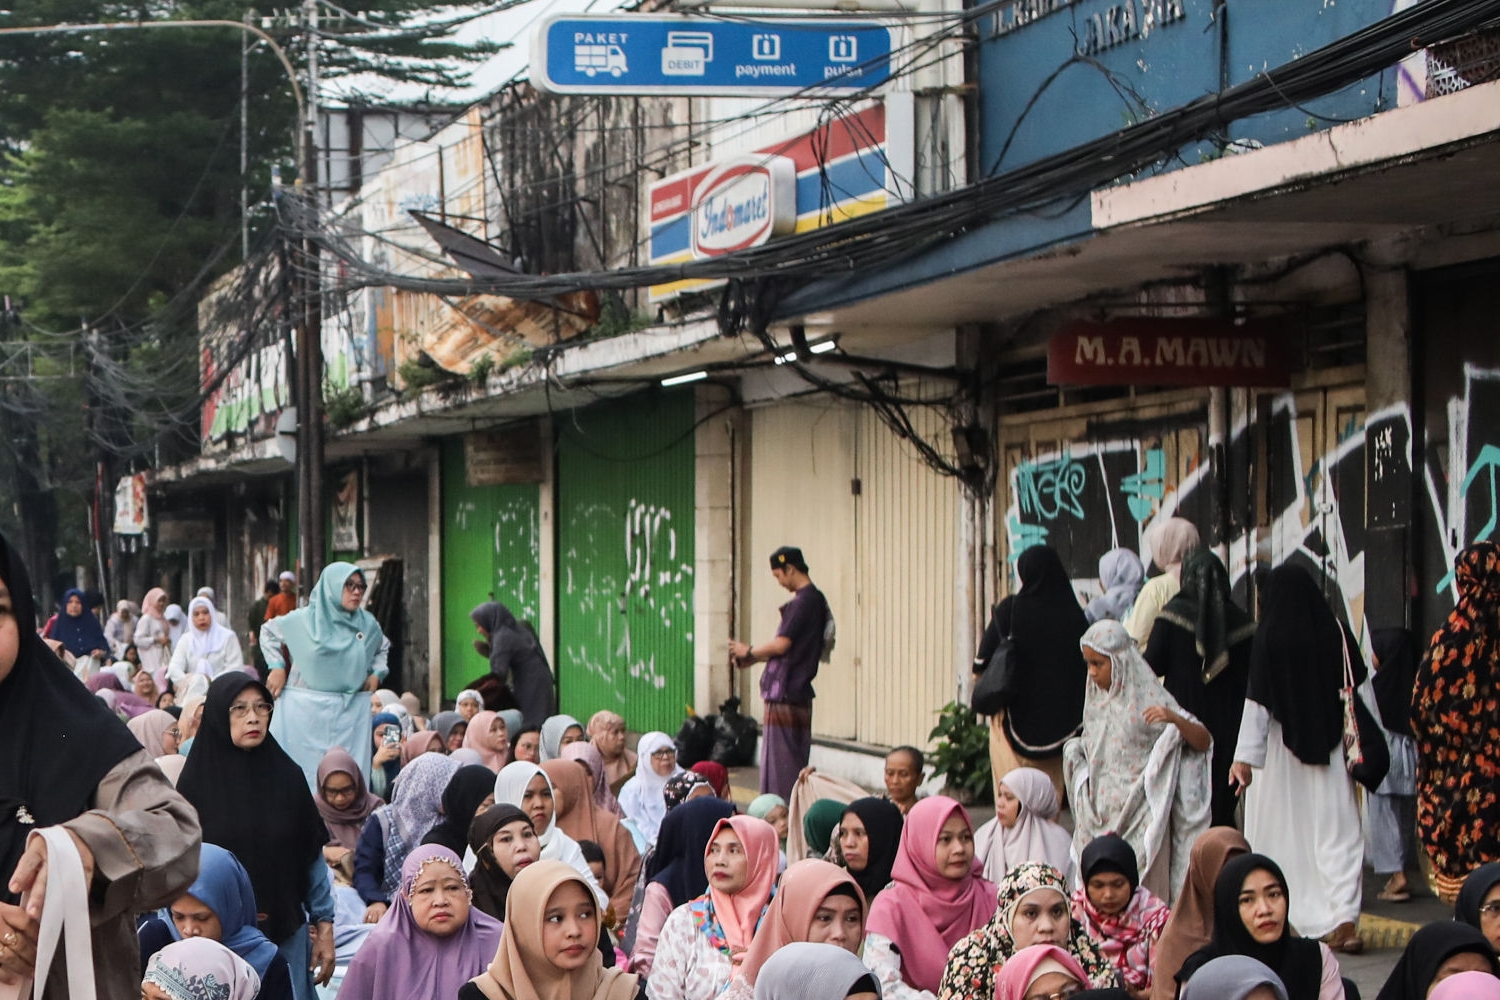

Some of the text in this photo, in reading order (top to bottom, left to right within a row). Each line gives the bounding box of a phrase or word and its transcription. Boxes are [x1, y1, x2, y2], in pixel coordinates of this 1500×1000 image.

[575, 33, 628, 43] PAKET
[668, 60, 700, 69] DEBIT
[736, 63, 796, 78] payment
[701, 184, 767, 239] Indomaret
